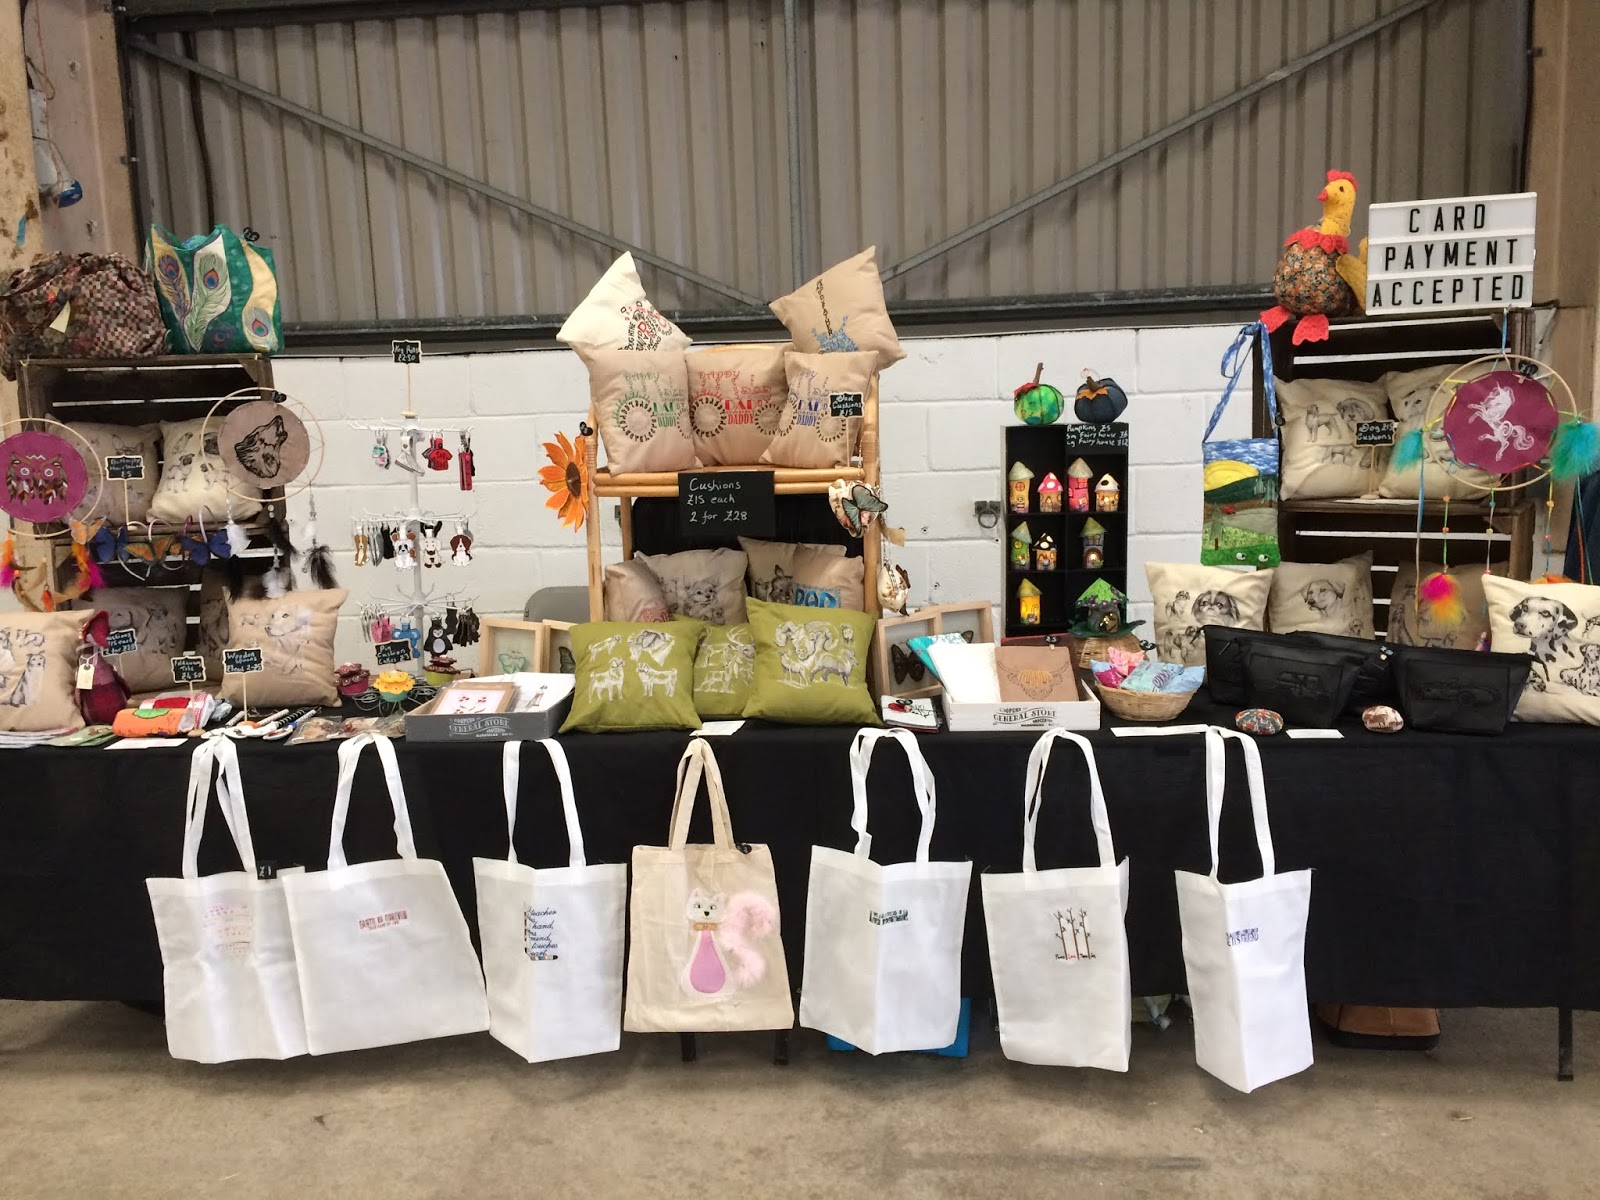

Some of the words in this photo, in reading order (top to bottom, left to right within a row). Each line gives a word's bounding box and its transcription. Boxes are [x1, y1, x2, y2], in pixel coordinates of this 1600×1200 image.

[1409, 203, 1486, 233] CARD
[1385, 238, 1518, 271] PAYMENT
[1372, 274, 1524, 307] ACCEPTED
[832, 401, 862, 410] Cushions
[727, 413, 754, 425] DADDY
[1066, 424, 1097, 433] Pumpkins
[1358, 423, 1381, 433] Dog
[1080, 431, 1097, 439] Fairy
[1357, 432, 1392, 440] Cushions
[1079, 437, 1096, 446] Fairy
[689, 477, 741, 491] Cushions
[687, 493, 705, 506] £15
[711, 493, 735, 504] each
[689, 511, 698, 522] 2
[701, 510, 718, 525] for
[723, 510, 748, 522] £28
[106, 632, 132, 641] ushions
[226, 652, 256, 660] Wooden
[993, 711, 1029, 722] GENERAL
[1031, 709, 1056, 717] STORE
[449, 721, 482, 733] GENERAL
[484, 718, 510, 726] STORE
[531, 907, 557, 917] teacher
[531, 940, 559, 950] touches
